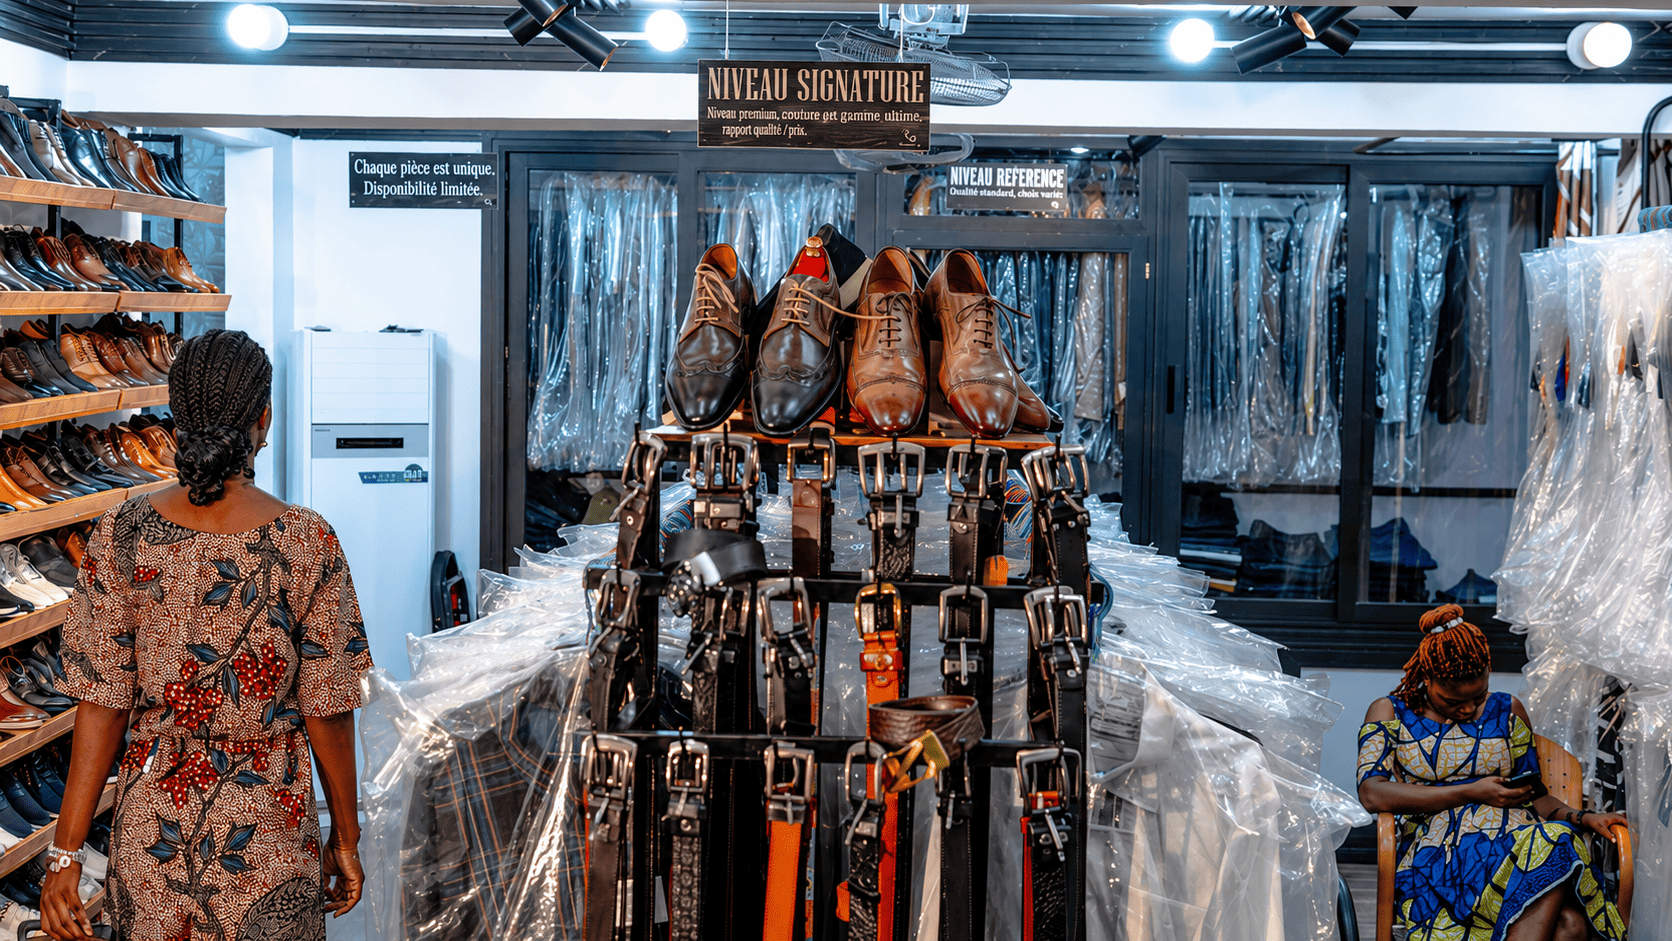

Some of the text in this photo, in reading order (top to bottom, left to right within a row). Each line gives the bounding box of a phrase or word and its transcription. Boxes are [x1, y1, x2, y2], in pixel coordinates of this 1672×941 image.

[708, 67, 924, 103] NIVEAU SIGNATURE
[707, 106, 736, 119] Niveau
[738, 108, 779, 122] premium,
[781, 109, 820, 120] couture
[722, 124, 752, 138] rapport
[354, 159, 496, 179] Chaque pièce est unique.
[950, 166, 993, 186] NIVEAU
[363, 181, 483, 199] Disponibilité limitée.
